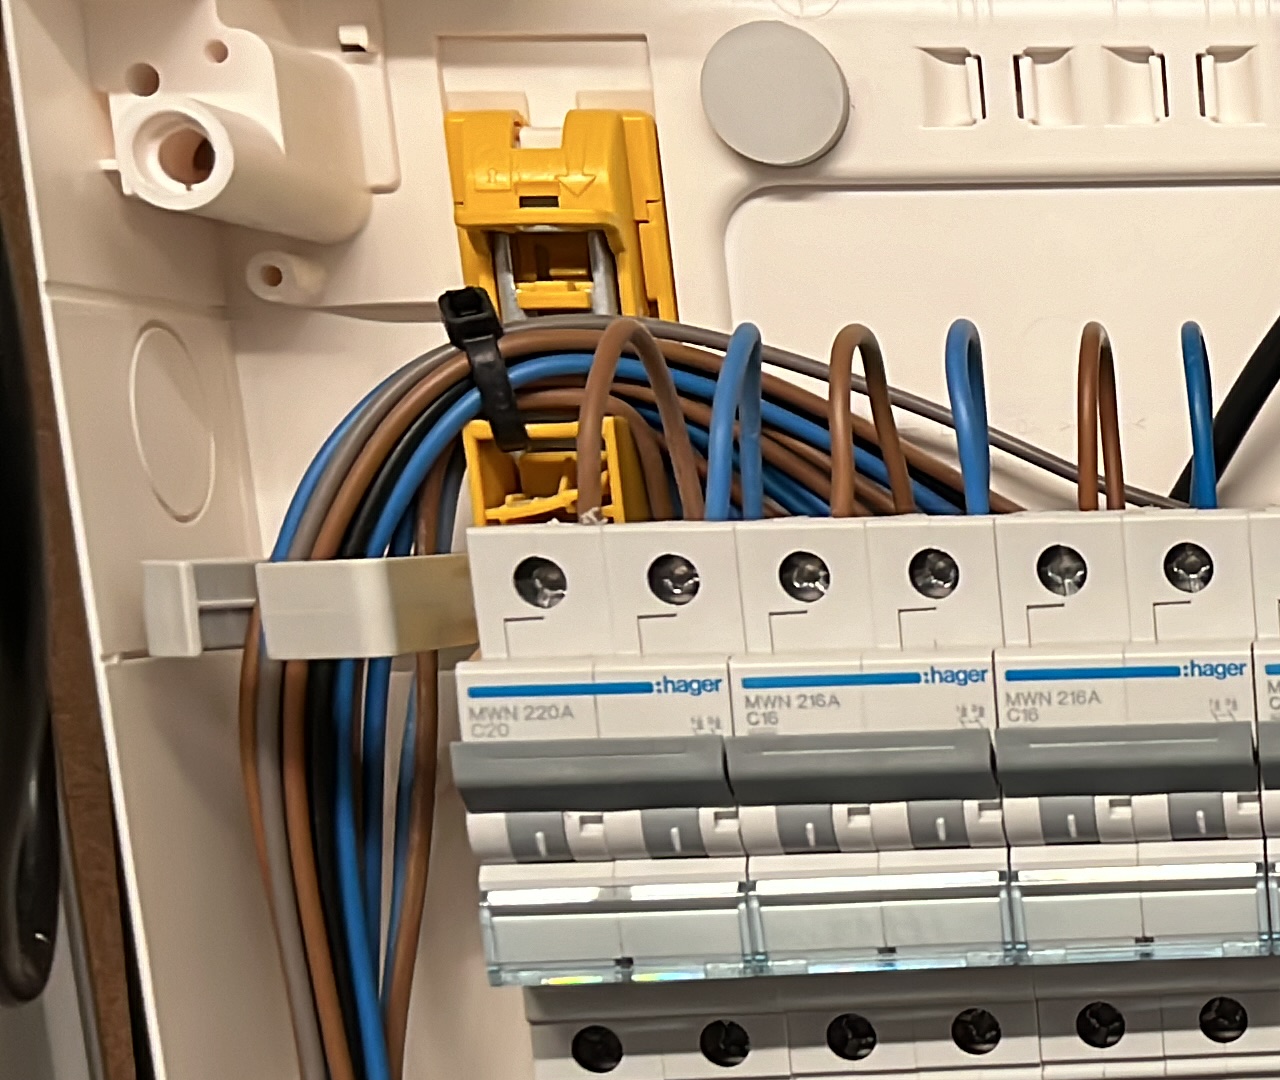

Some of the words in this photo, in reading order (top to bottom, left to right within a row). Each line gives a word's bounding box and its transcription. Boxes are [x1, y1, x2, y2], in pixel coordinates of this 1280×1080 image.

[745, 694, 793, 711] MWN
[796, 693, 841, 710] 216A
[1004, 692, 1053, 708] MWN
[1056, 690, 1101, 706] 216A
[468, 704, 520, 723] MWN
[523, 703, 575, 722] 220A
[747, 710, 780, 727] C16
[1006, 707, 1040, 723] C16
[471, 722, 510, 738] C20
